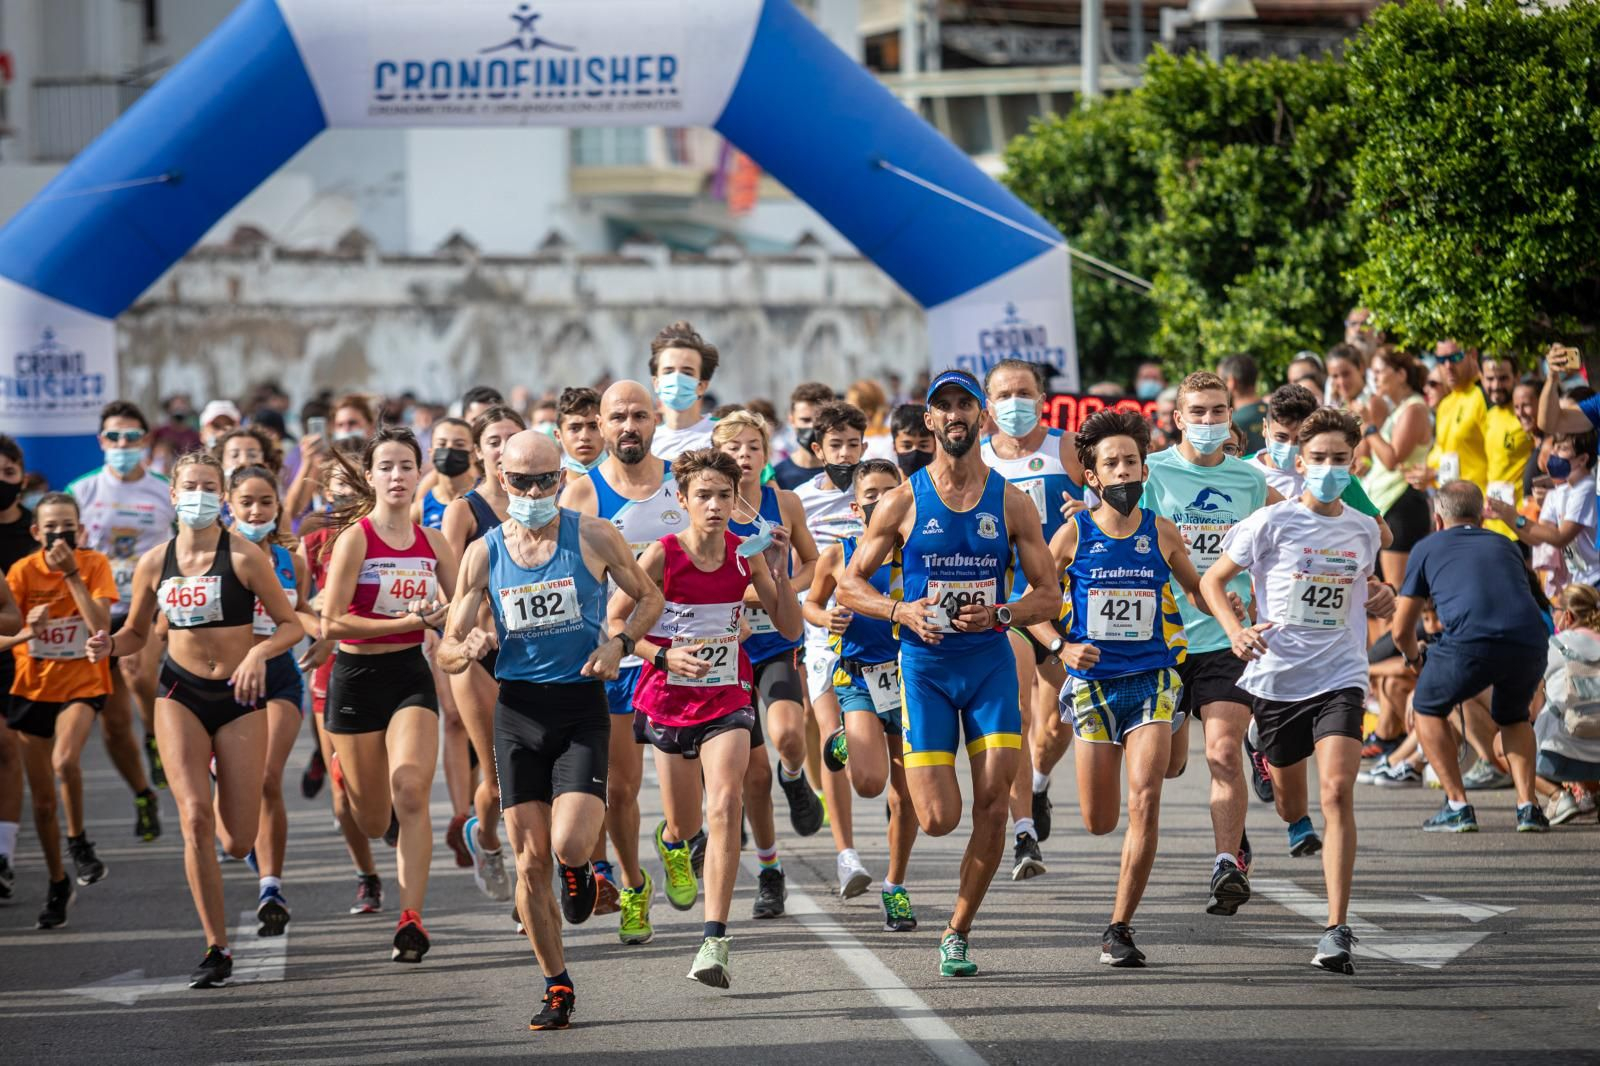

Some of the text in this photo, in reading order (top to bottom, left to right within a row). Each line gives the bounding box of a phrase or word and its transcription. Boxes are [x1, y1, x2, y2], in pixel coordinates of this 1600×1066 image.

[374, 55, 679, 101] CRONOFINISHER
[980, 324, 1047, 352] CRONO
[14, 351, 84, 377] CRONO
[1193, 533, 1226, 554] 42
[922, 553, 997, 568] Tirabuzón
[1089, 566, 1154, 579] Tirabuzón
[389, 579, 427, 599] 464
[520, 584, 545, 594] MILLA
[547, 579, 573, 589] VERDE
[975, 580, 995, 588] VERDE
[165, 586, 207, 607] 465
[514, 592, 565, 620] 182
[1301, 585, 1344, 609] 425
[1100, 599, 1141, 621] 421
[37, 624, 78, 645] 467
[550, 622, 585, 635] Caminos
[720, 634, 737, 644] VERDE
